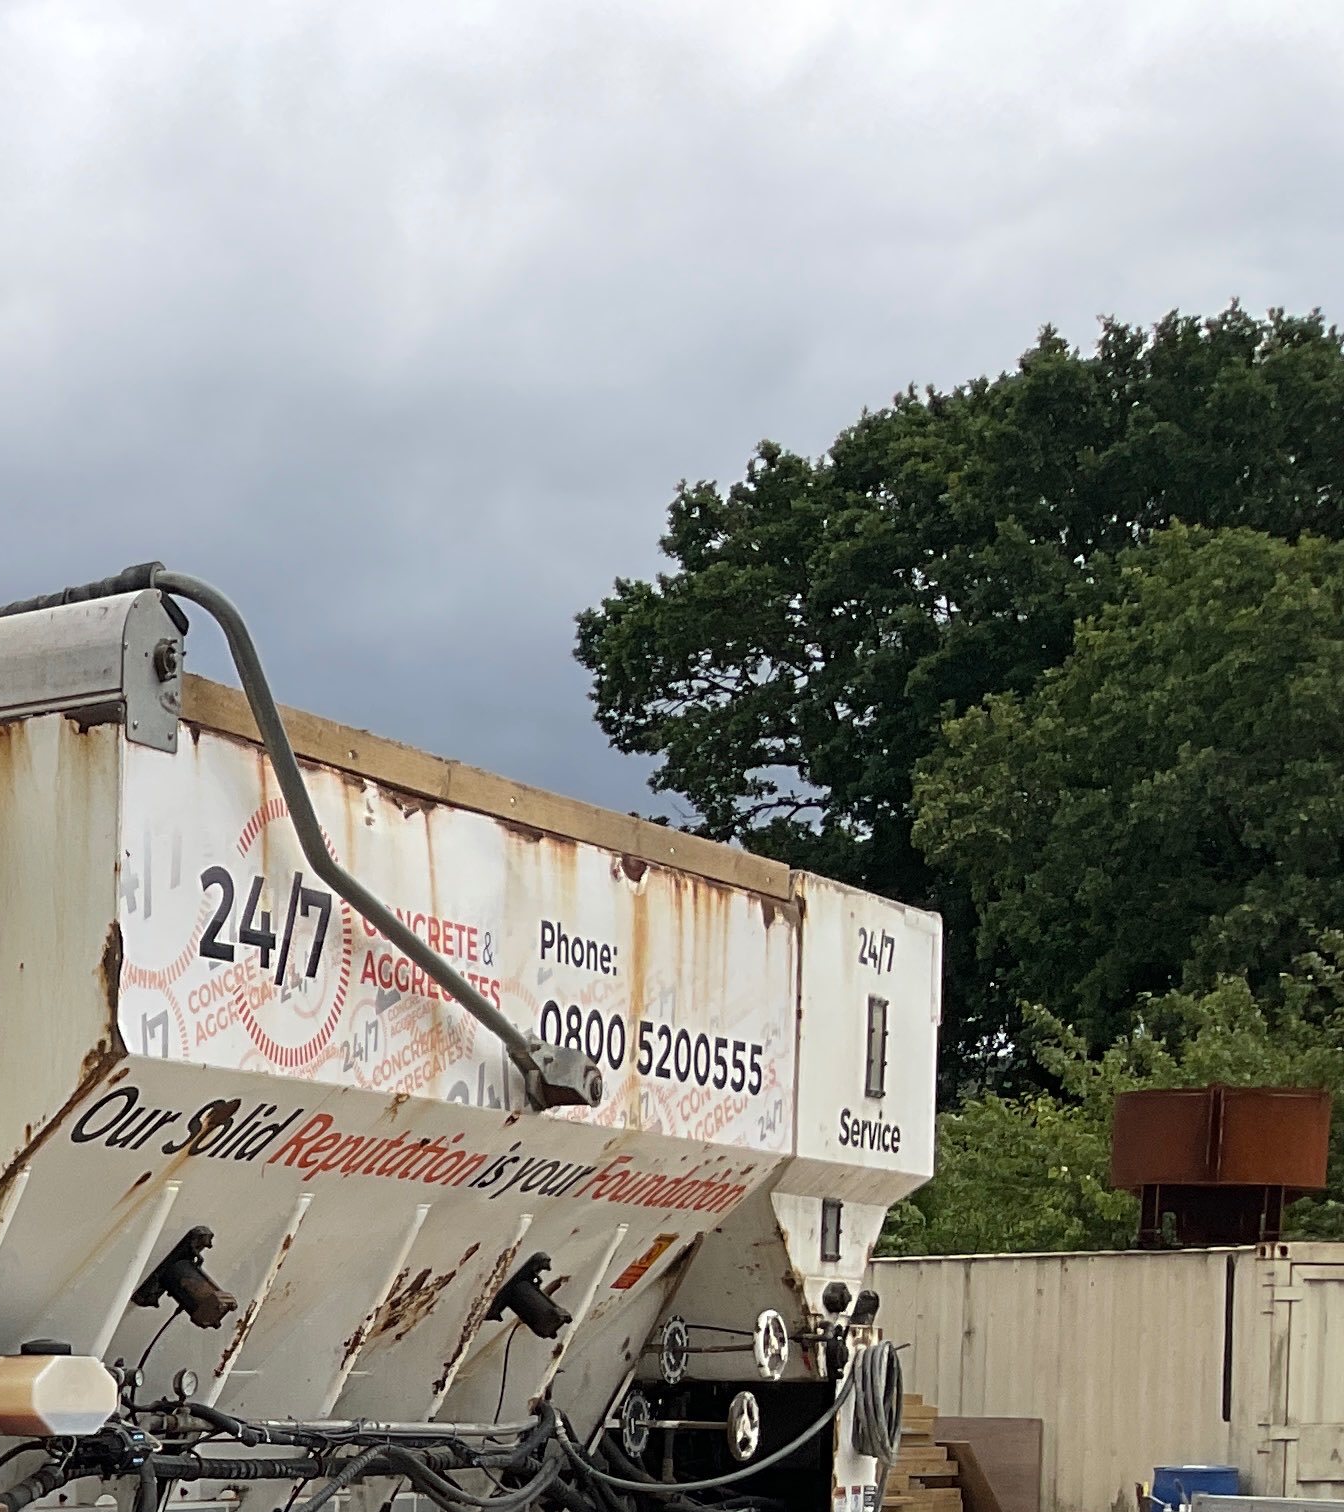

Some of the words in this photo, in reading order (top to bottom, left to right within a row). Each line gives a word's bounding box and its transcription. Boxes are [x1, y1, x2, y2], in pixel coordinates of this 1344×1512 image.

[199, 866, 332, 986] 24/7
[482, 931, 494, 967] &
[540, 919, 618, 976] Phone:
[858, 927, 895, 975] 24/7
[540, 1000, 625, 1070] 0800
[637, 1020, 763, 1095] 5200555
[70, 1086, 182, 1150] Our
[162, 1098, 304, 1162] Solid
[838, 1107, 902, 1154] Service
[266, 1112, 488, 1187] Reputation
[467, 1141, 521, 1189] is
[488, 1156, 597, 1200] your
[573, 1155, 750, 1213] Foundation
